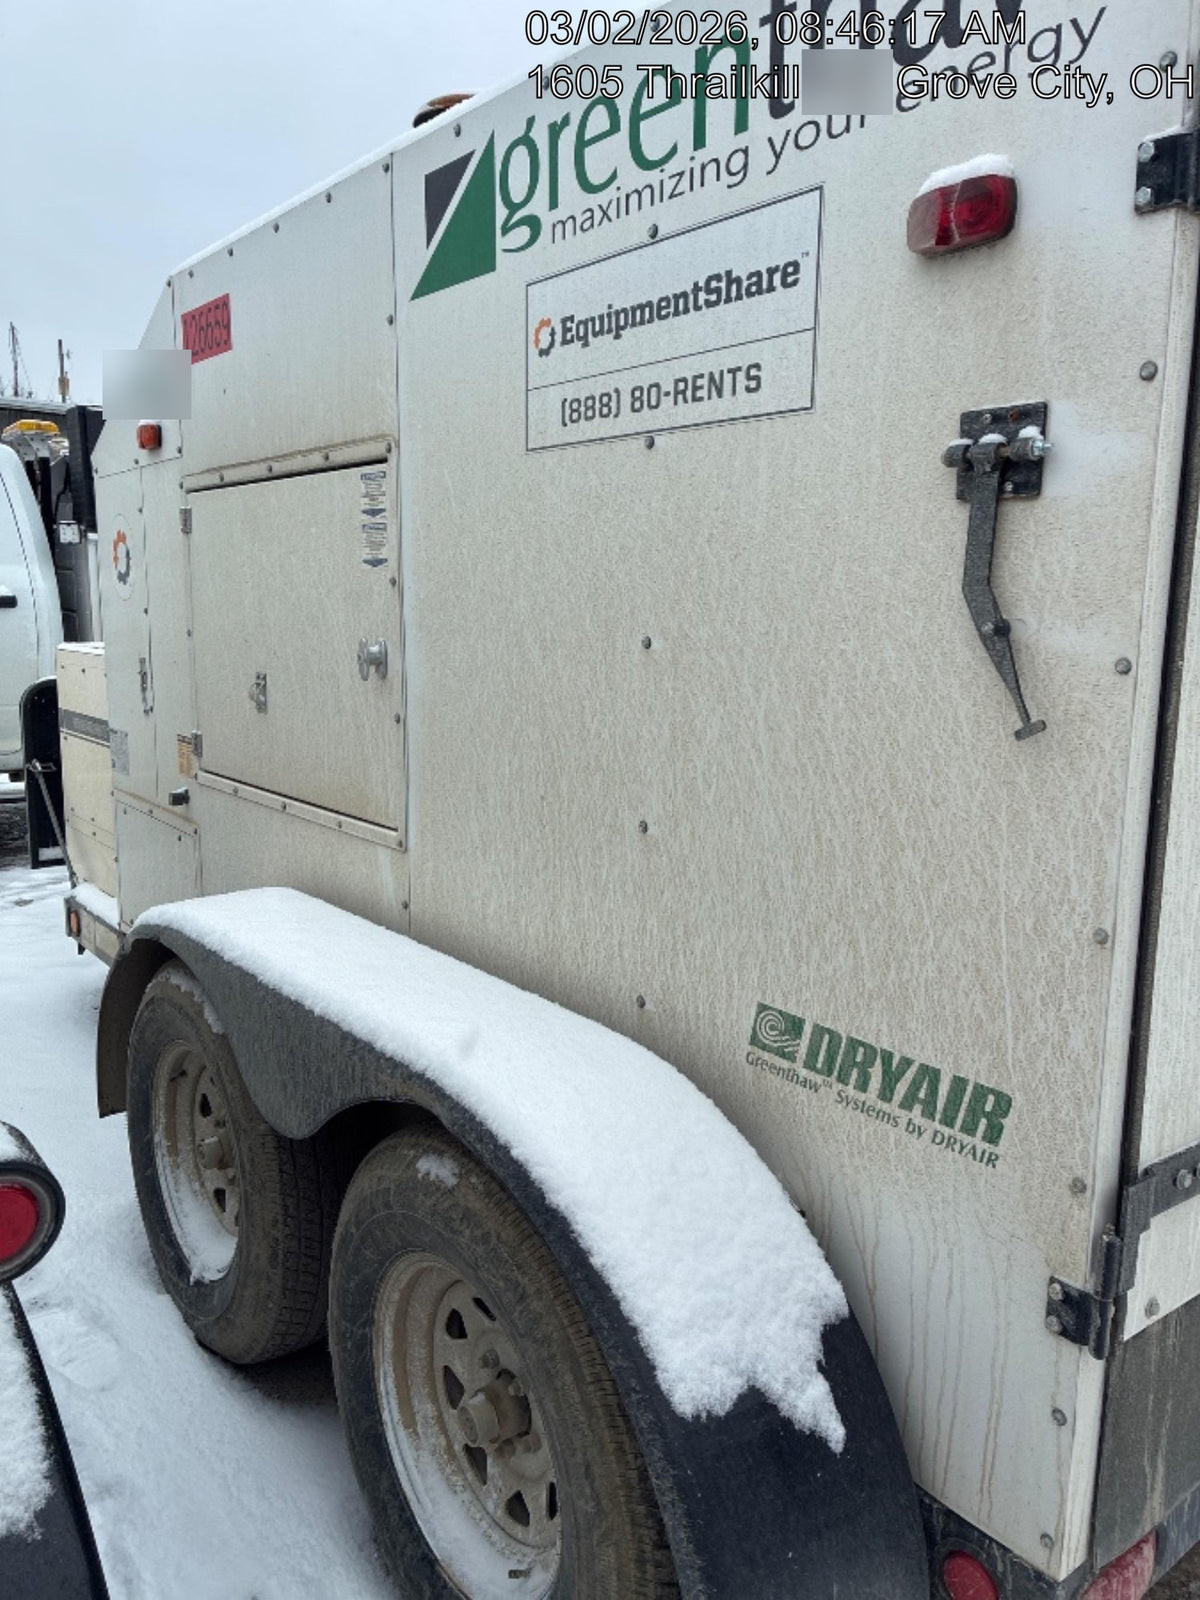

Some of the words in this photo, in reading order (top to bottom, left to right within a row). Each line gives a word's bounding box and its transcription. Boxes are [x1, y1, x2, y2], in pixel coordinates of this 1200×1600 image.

[551, 145, 749, 244] maximizing
[561, 387, 620, 427] (888)
[630, 362, 762, 413] 80-RENTS
[803, 1022, 1012, 1147] DRYAIR
[836, 1089, 900, 1128] Systems
[905, 1117, 927, 1140] by
[931, 1129, 1000, 1169] DRYAIR
